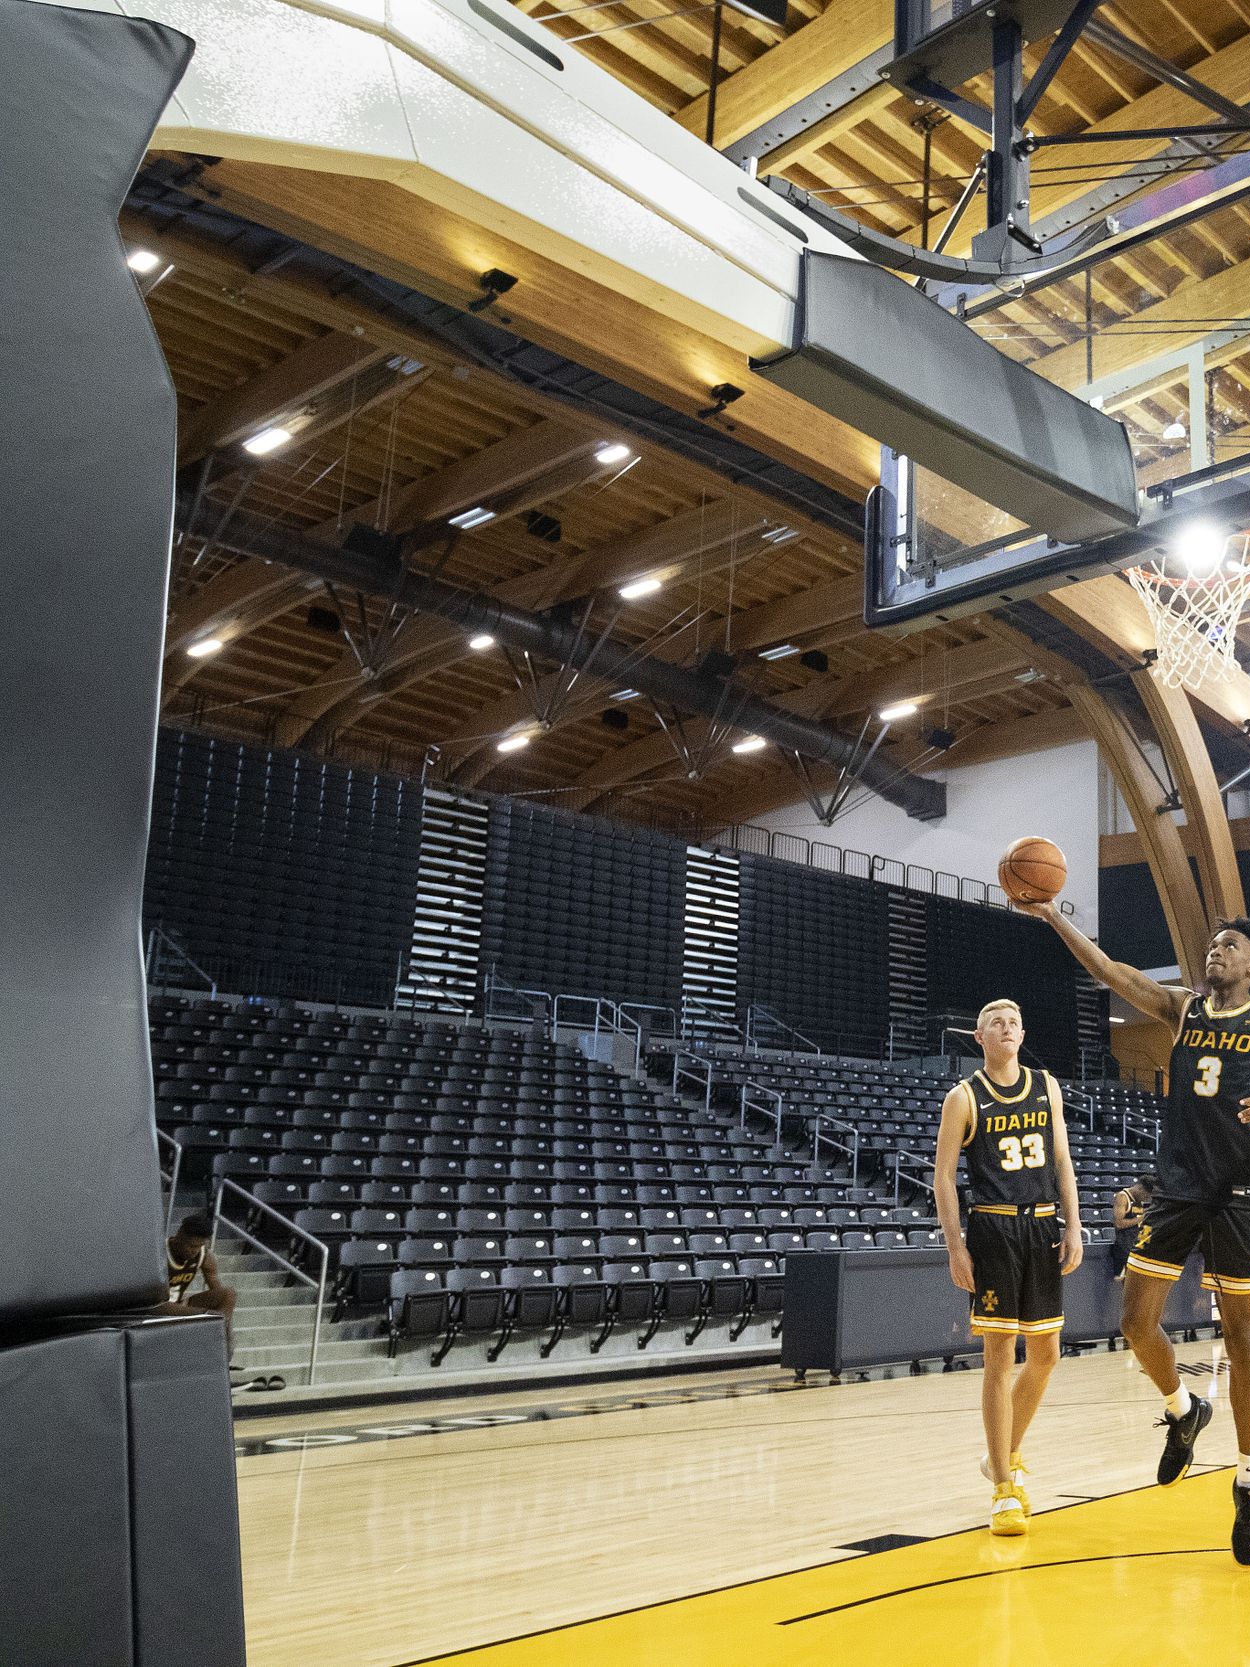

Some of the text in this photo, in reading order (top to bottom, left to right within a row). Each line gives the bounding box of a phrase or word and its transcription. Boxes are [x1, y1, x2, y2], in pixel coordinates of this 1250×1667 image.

[1193, 1056, 1222, 1097] 3
[986, 1111, 1048, 1133] IDAHO
[998, 1132, 1046, 1172] 33
